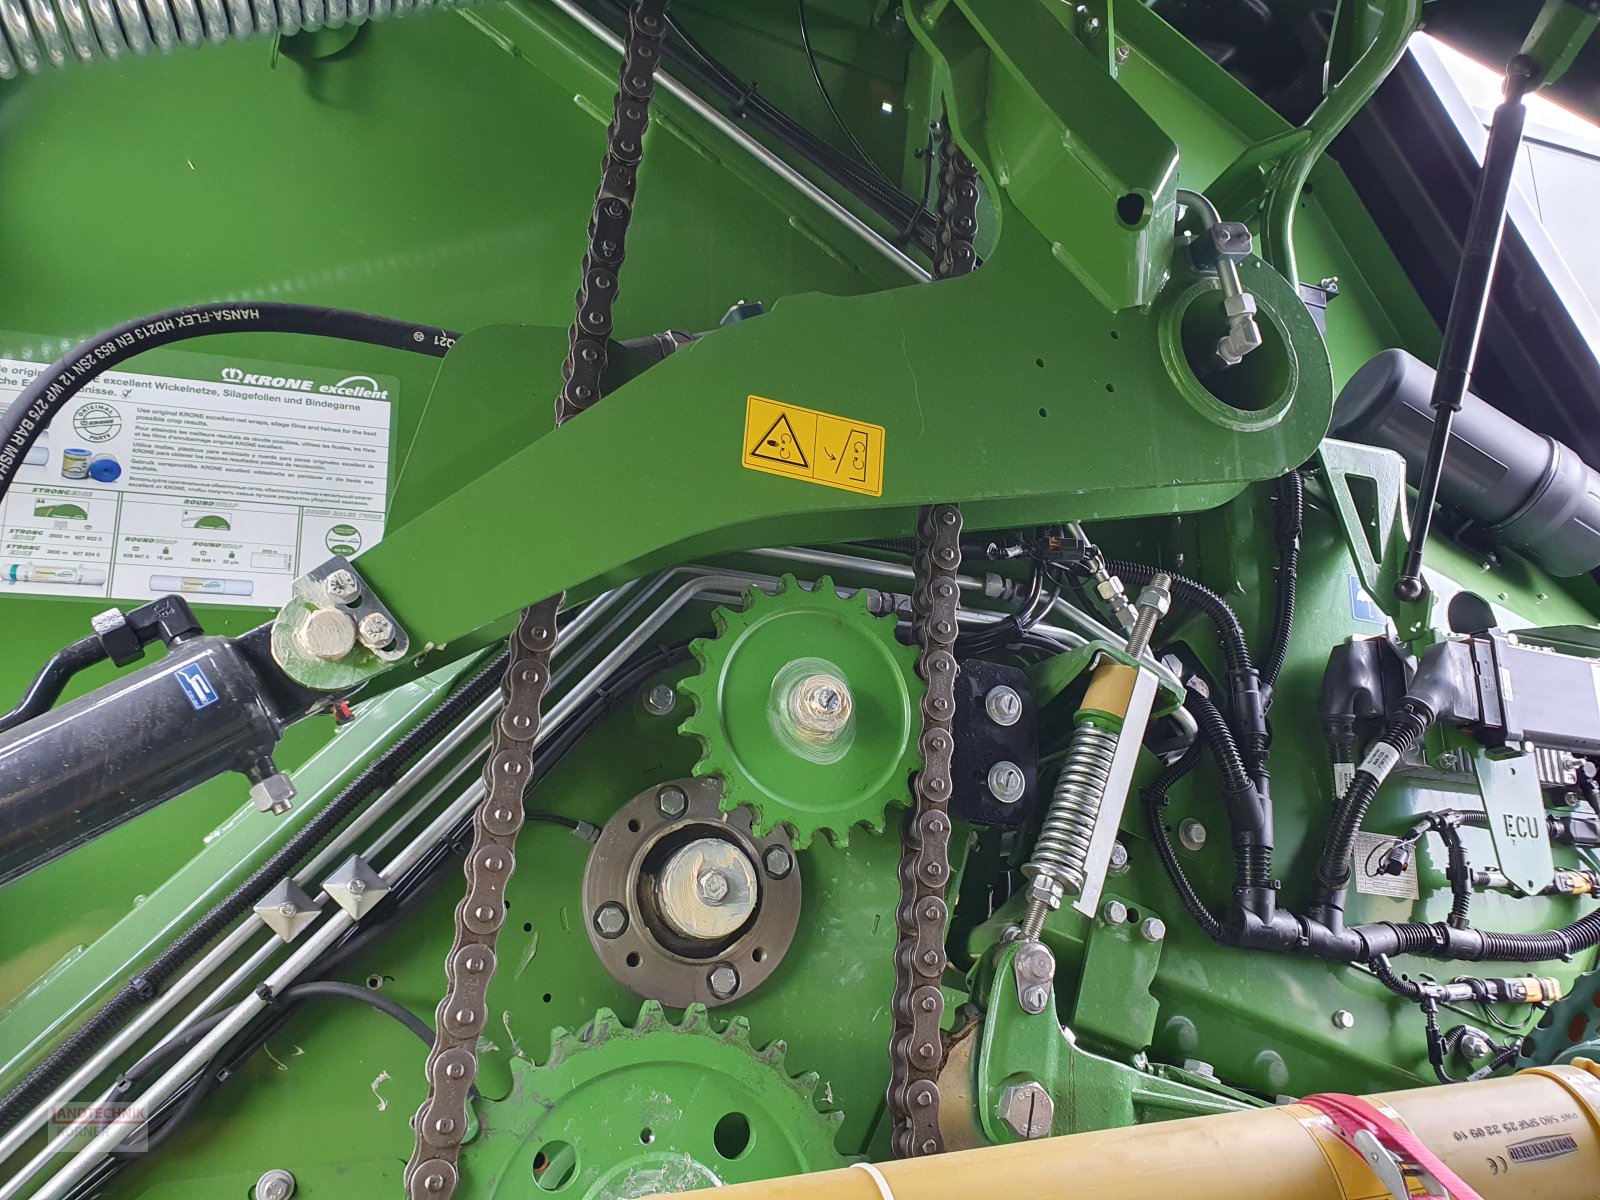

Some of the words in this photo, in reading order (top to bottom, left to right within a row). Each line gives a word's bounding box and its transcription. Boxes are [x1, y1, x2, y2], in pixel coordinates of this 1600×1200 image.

[178, 309, 260, 328] HANSA-FLEX
[135, 320, 174, 340] HD213
[94, 341, 117, 361] 853
[117, 333, 136, 349] EN
[72, 354, 97, 376] 2SN
[59, 371, 76, 386] 12
[244, 373, 314, 391] KRONE
[319, 382, 388, 400] excellent
[45, 382, 65, 402] WP
[103, 377, 152, 389] excellent
[154, 382, 220, 397] Wickelnetze,
[223, 389, 281, 403] Silagefolien
[283, 397, 302, 405] und
[305, 398, 361, 412] Bindegarne
[28, 398, 49, 421] 275
[78, 405, 113, 417] ORIGINAL
[152, 409, 177, 417] original
[179, 411, 204, 419] KRONE
[10, 418, 35, 446] BAR
[1503, 814, 1538, 838] ECU
[1509, 1136, 1578, 1160] WALTERSCHEID
